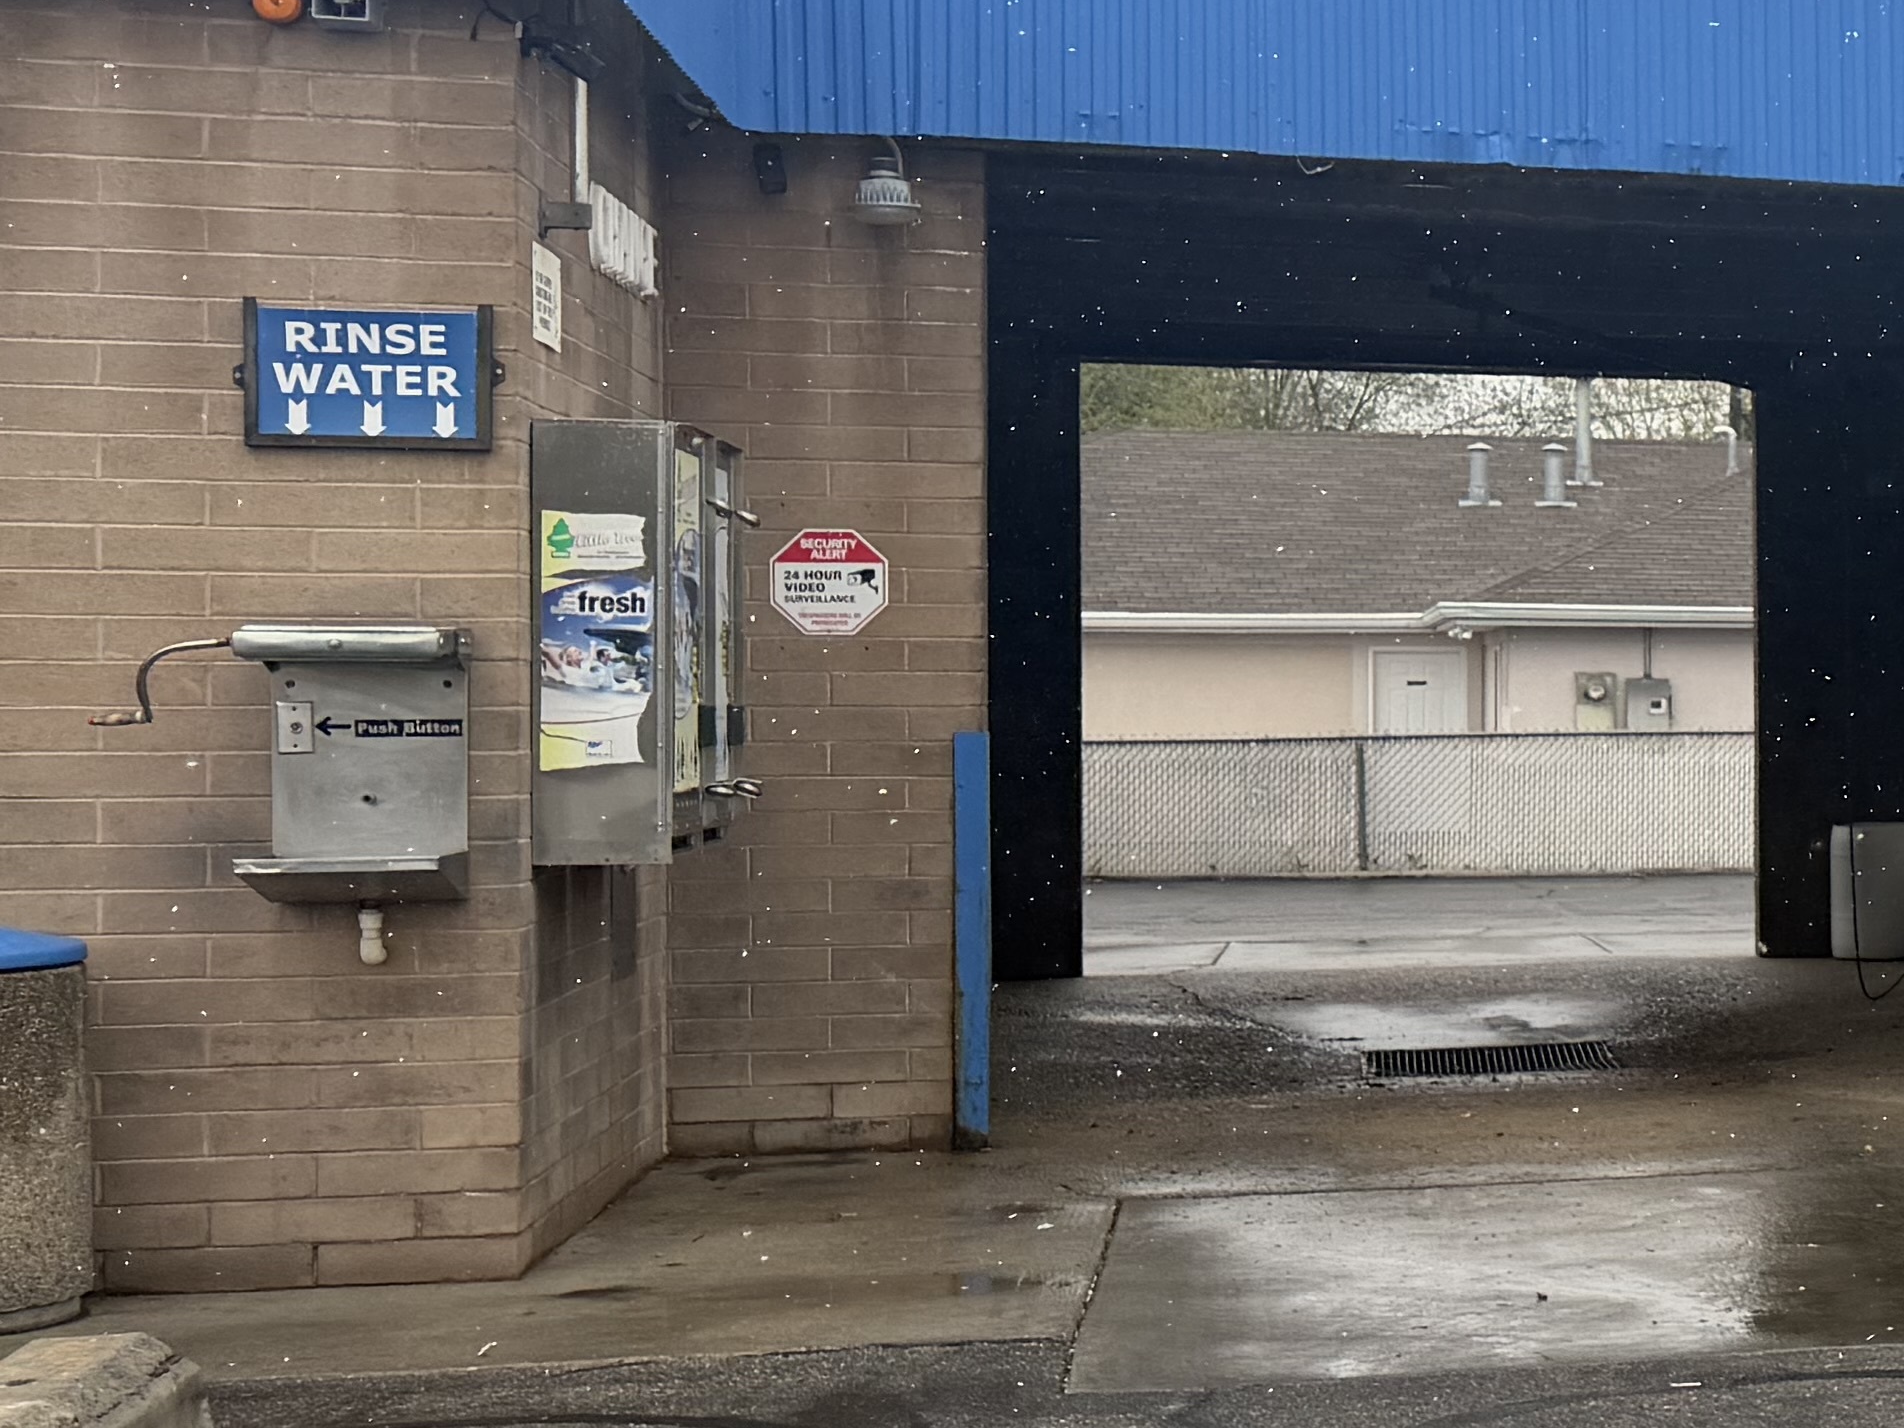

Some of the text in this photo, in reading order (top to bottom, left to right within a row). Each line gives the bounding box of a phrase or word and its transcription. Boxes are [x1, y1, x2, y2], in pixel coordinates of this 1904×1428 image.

[284, 320, 448, 356] RINSE
[272, 361, 462, 397] WATER
[800, 537, 858, 550] SECURITY
[810, 549, 848, 560] ALERT
[783, 570, 842, 581] 24 HOUR
[784, 582, 826, 593] VIDEO
[578, 590, 646, 614] fresh
[784, 594, 856, 604] SURVEILLANCE
[357, 719, 460, 735] Push Button
